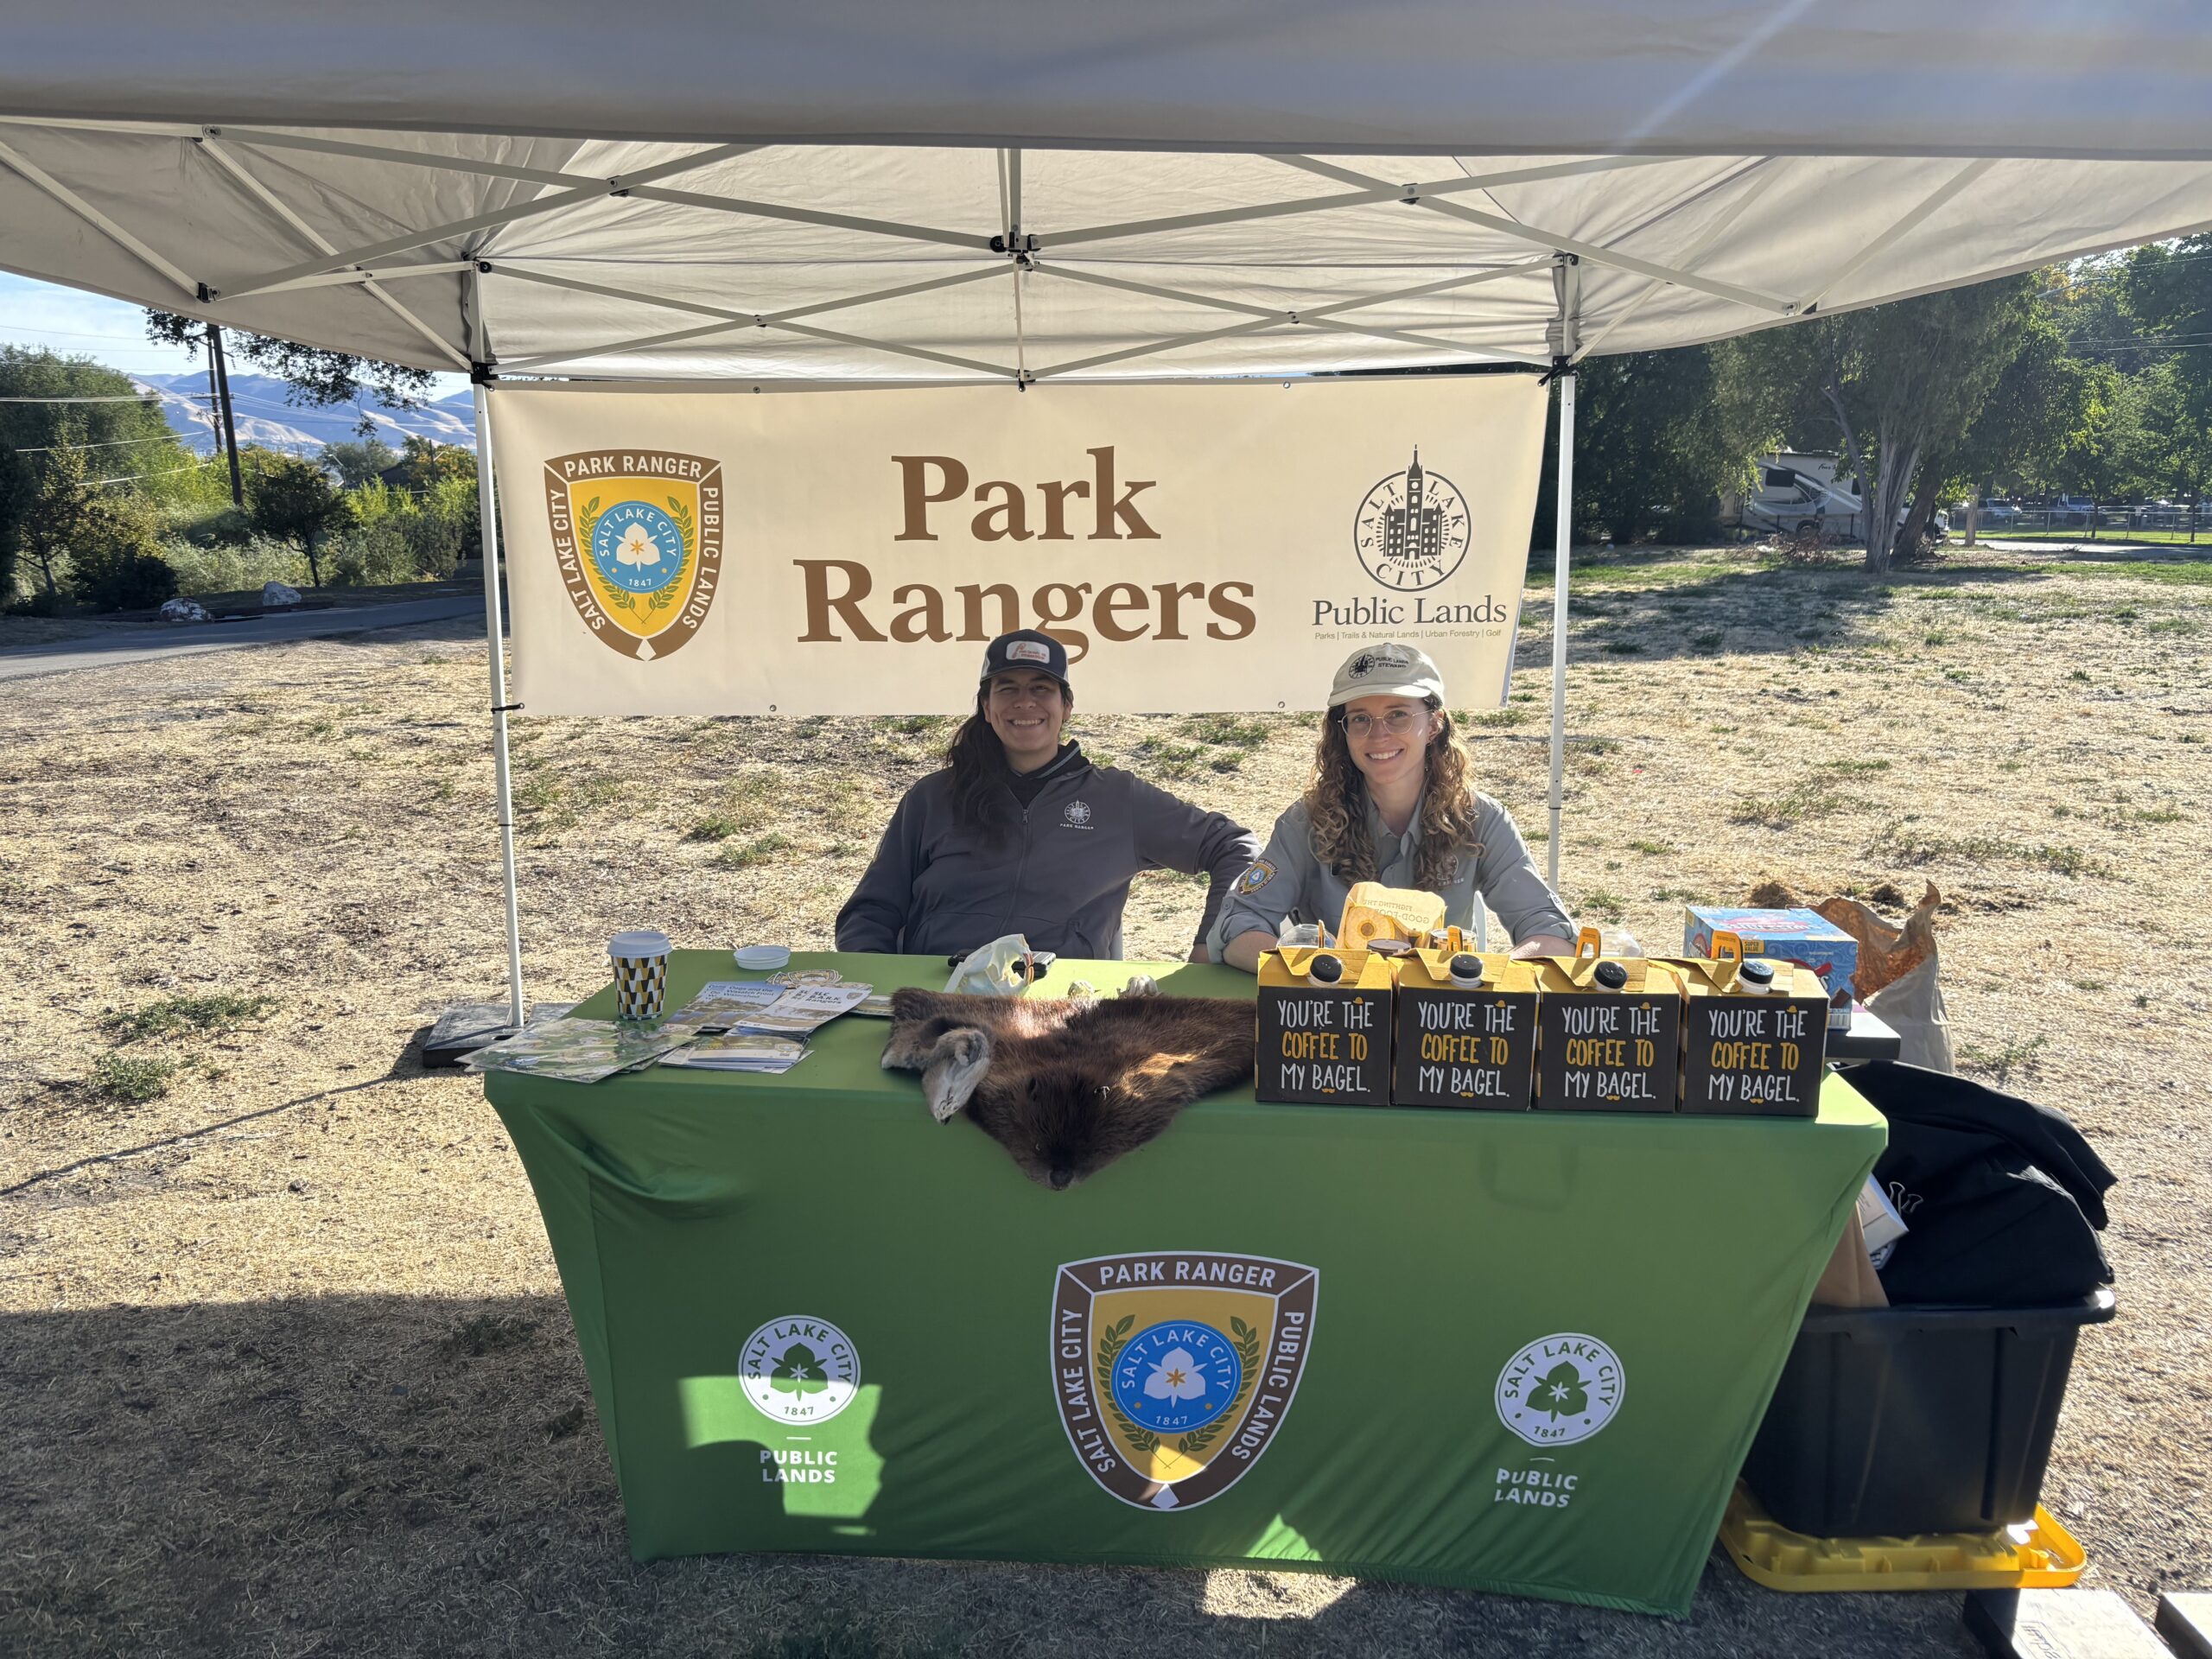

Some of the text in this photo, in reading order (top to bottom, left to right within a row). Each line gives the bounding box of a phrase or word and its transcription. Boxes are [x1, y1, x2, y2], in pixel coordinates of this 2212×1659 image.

[563, 455, 702, 479] PARK RANGER
[891, 446, 1161, 542] Park
[599, 508, 677, 557] SALT LAKE CITY
[1361, 480, 1465, 587] SALT LAKE CITY
[550, 489, 606, 630] SALT LAKE CITY
[682, 486, 720, 629] PUBLIC LANDS
[628, 578, 652, 588] 1847
[792, 559, 1256, 665] Rangers
[1312, 594, 1507, 626] Public Lands
[1450, 630, 1480, 639] Forestry
[1277, 999, 1374, 1029] YOU'RE THE
[1418, 1001, 1516, 1033] YOU'RE THE
[1562, 1005, 1662, 1035] YOU'RE THE
[1708, 1009, 1808, 1039] YOU'RE THE
[1281, 1031, 1368, 1061] COFFEE TO
[1421, 1033, 1509, 1065] COFFEE TO
[1566, 1039, 1655, 1068] COFFEE TO
[1711, 1041, 1799, 1071] COFFEE TO
[1281, 1063, 1371, 1093] MY BAGEL.
[1419, 1065, 1510, 1097] MY BAGEL.
[1564, 1071, 1656, 1100] MY BAGEL.
[1708, 1074, 1800, 1103] MY BAGEL.
[1100, 1261, 1277, 1288] PARK RANGER
[747, 1323, 852, 1382] SALT LAKE CITY
[1122, 1329, 1232, 1389] SALT LAKE CITY
[1230, 1311, 1306, 1460] PUBLIC LANDS
[1504, 1341, 1616, 1407] SALT LAKE CITY
[1061, 1308, 1116, 1472] SALT LAKE CITY
[784, 1406, 814, 1416] 1847
[1155, 1414, 1188, 1426] 1847
[1533, 1426, 1566, 1438] 1847
[760, 1450, 838, 1465] PUBLIC
[762, 1468, 836, 1483] LANDS
[1496, 1467, 1578, 1491] PUBLIC
[1494, 1487, 1570, 1508] LANDS
